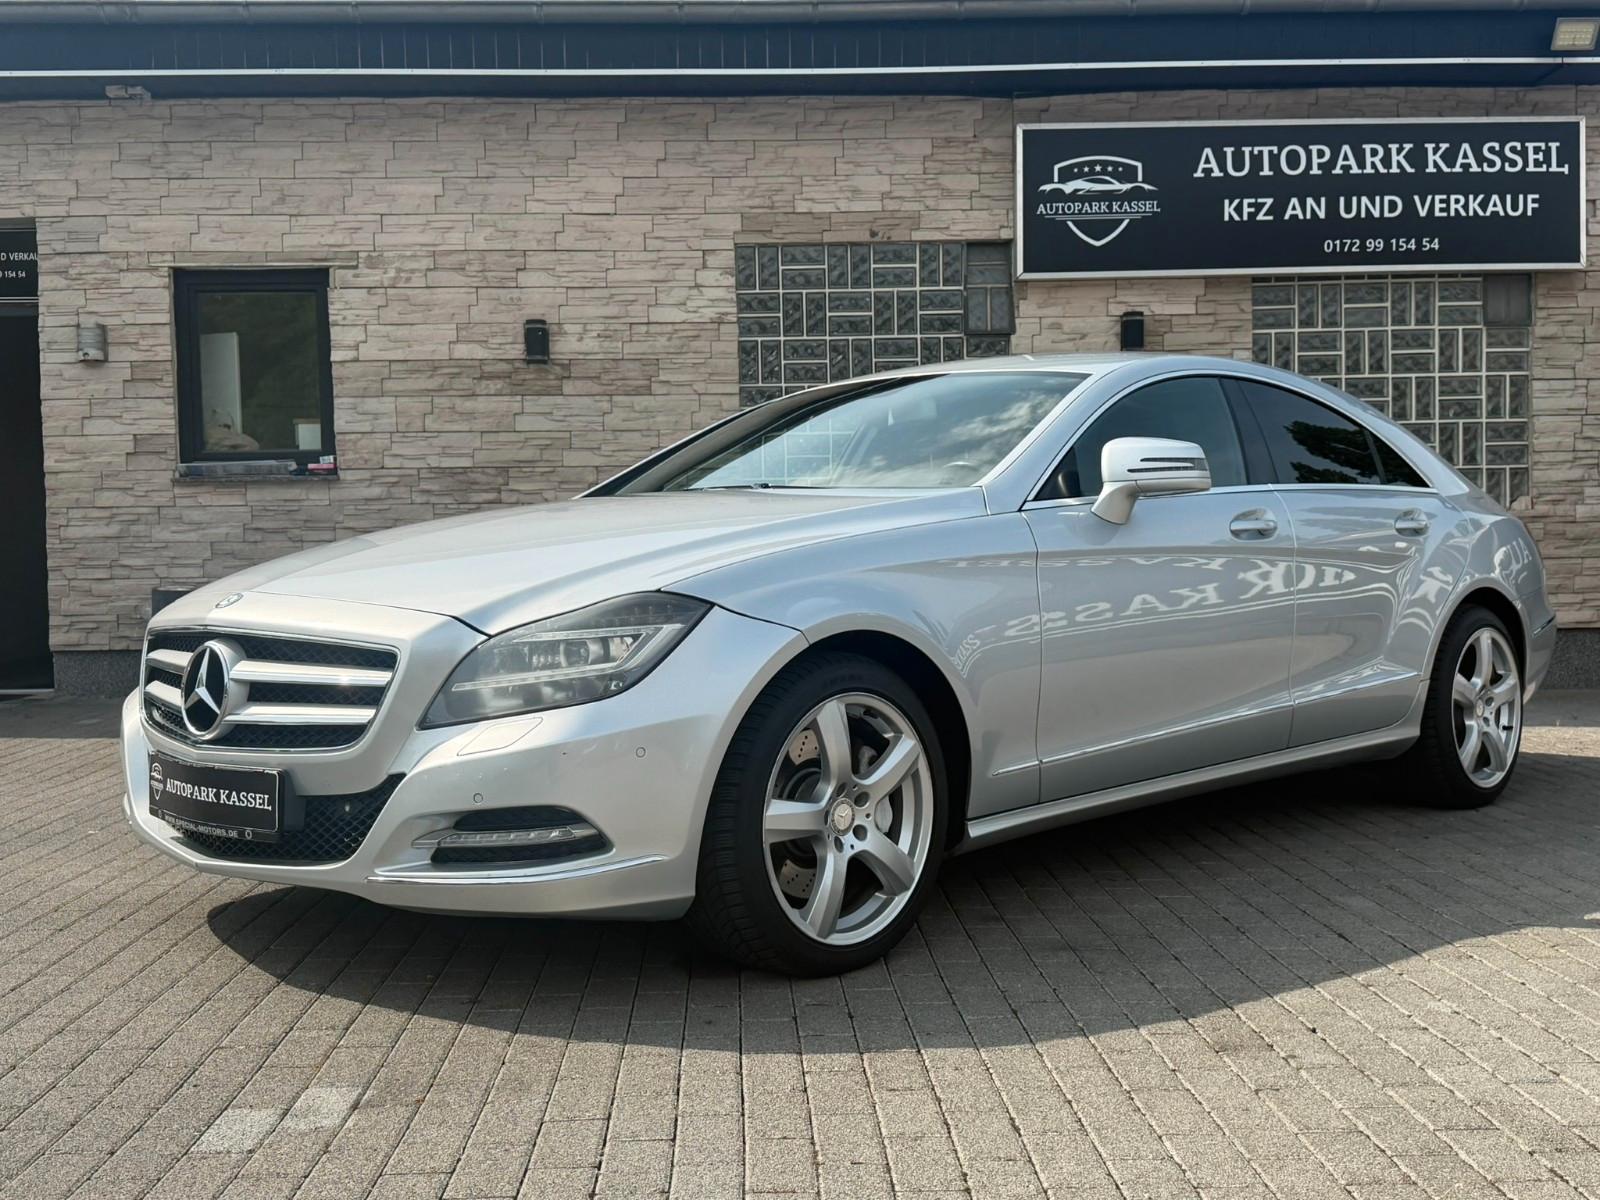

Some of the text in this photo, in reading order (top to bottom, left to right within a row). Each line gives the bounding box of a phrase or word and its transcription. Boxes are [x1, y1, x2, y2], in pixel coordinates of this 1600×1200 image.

[1193, 141, 1569, 178] AUTOPARK KASSEL
[1036, 200, 1161, 215] AUTOPARK KASSEL
[1223, 193, 1540, 222] KFZ AN UND VERKAUF
[1323, 237, 1440, 253] 0172 99 154 54
[165, 778, 218, 803] AUTOPARK
[219, 788, 272, 811] KASSEL
